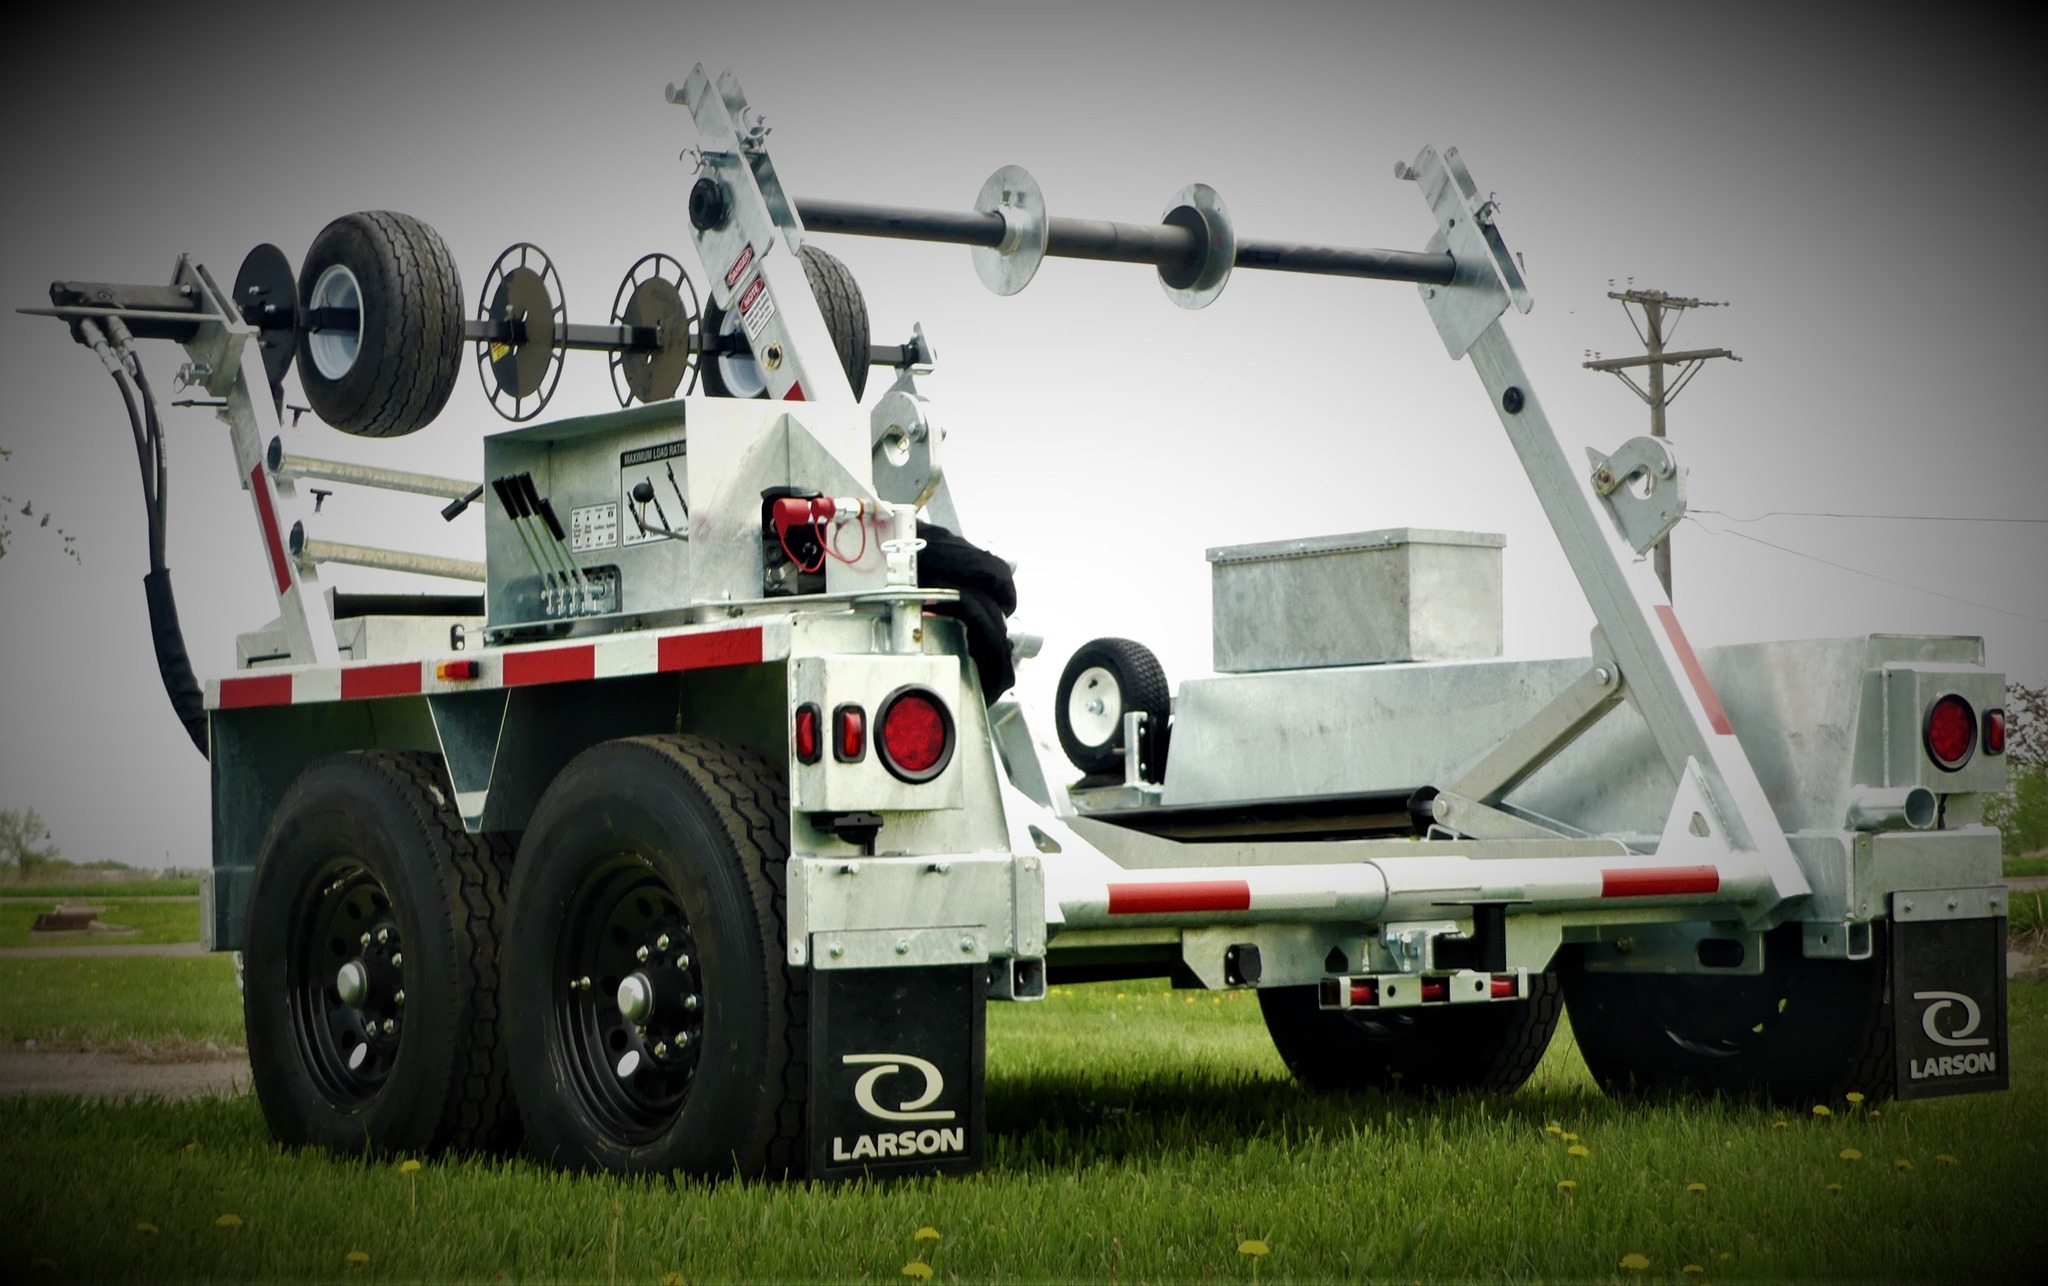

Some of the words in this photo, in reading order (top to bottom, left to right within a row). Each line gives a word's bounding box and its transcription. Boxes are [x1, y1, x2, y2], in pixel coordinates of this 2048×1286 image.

[728, 249, 751, 284] DANGER
[744, 284, 759, 307] NOTE
[624, 449, 652, 465] MAXIMUM
[653, 445, 669, 460] LOAD
[1910, 1052, 1996, 1079] LARSON
[833, 1127, 964, 1161] LARSON
